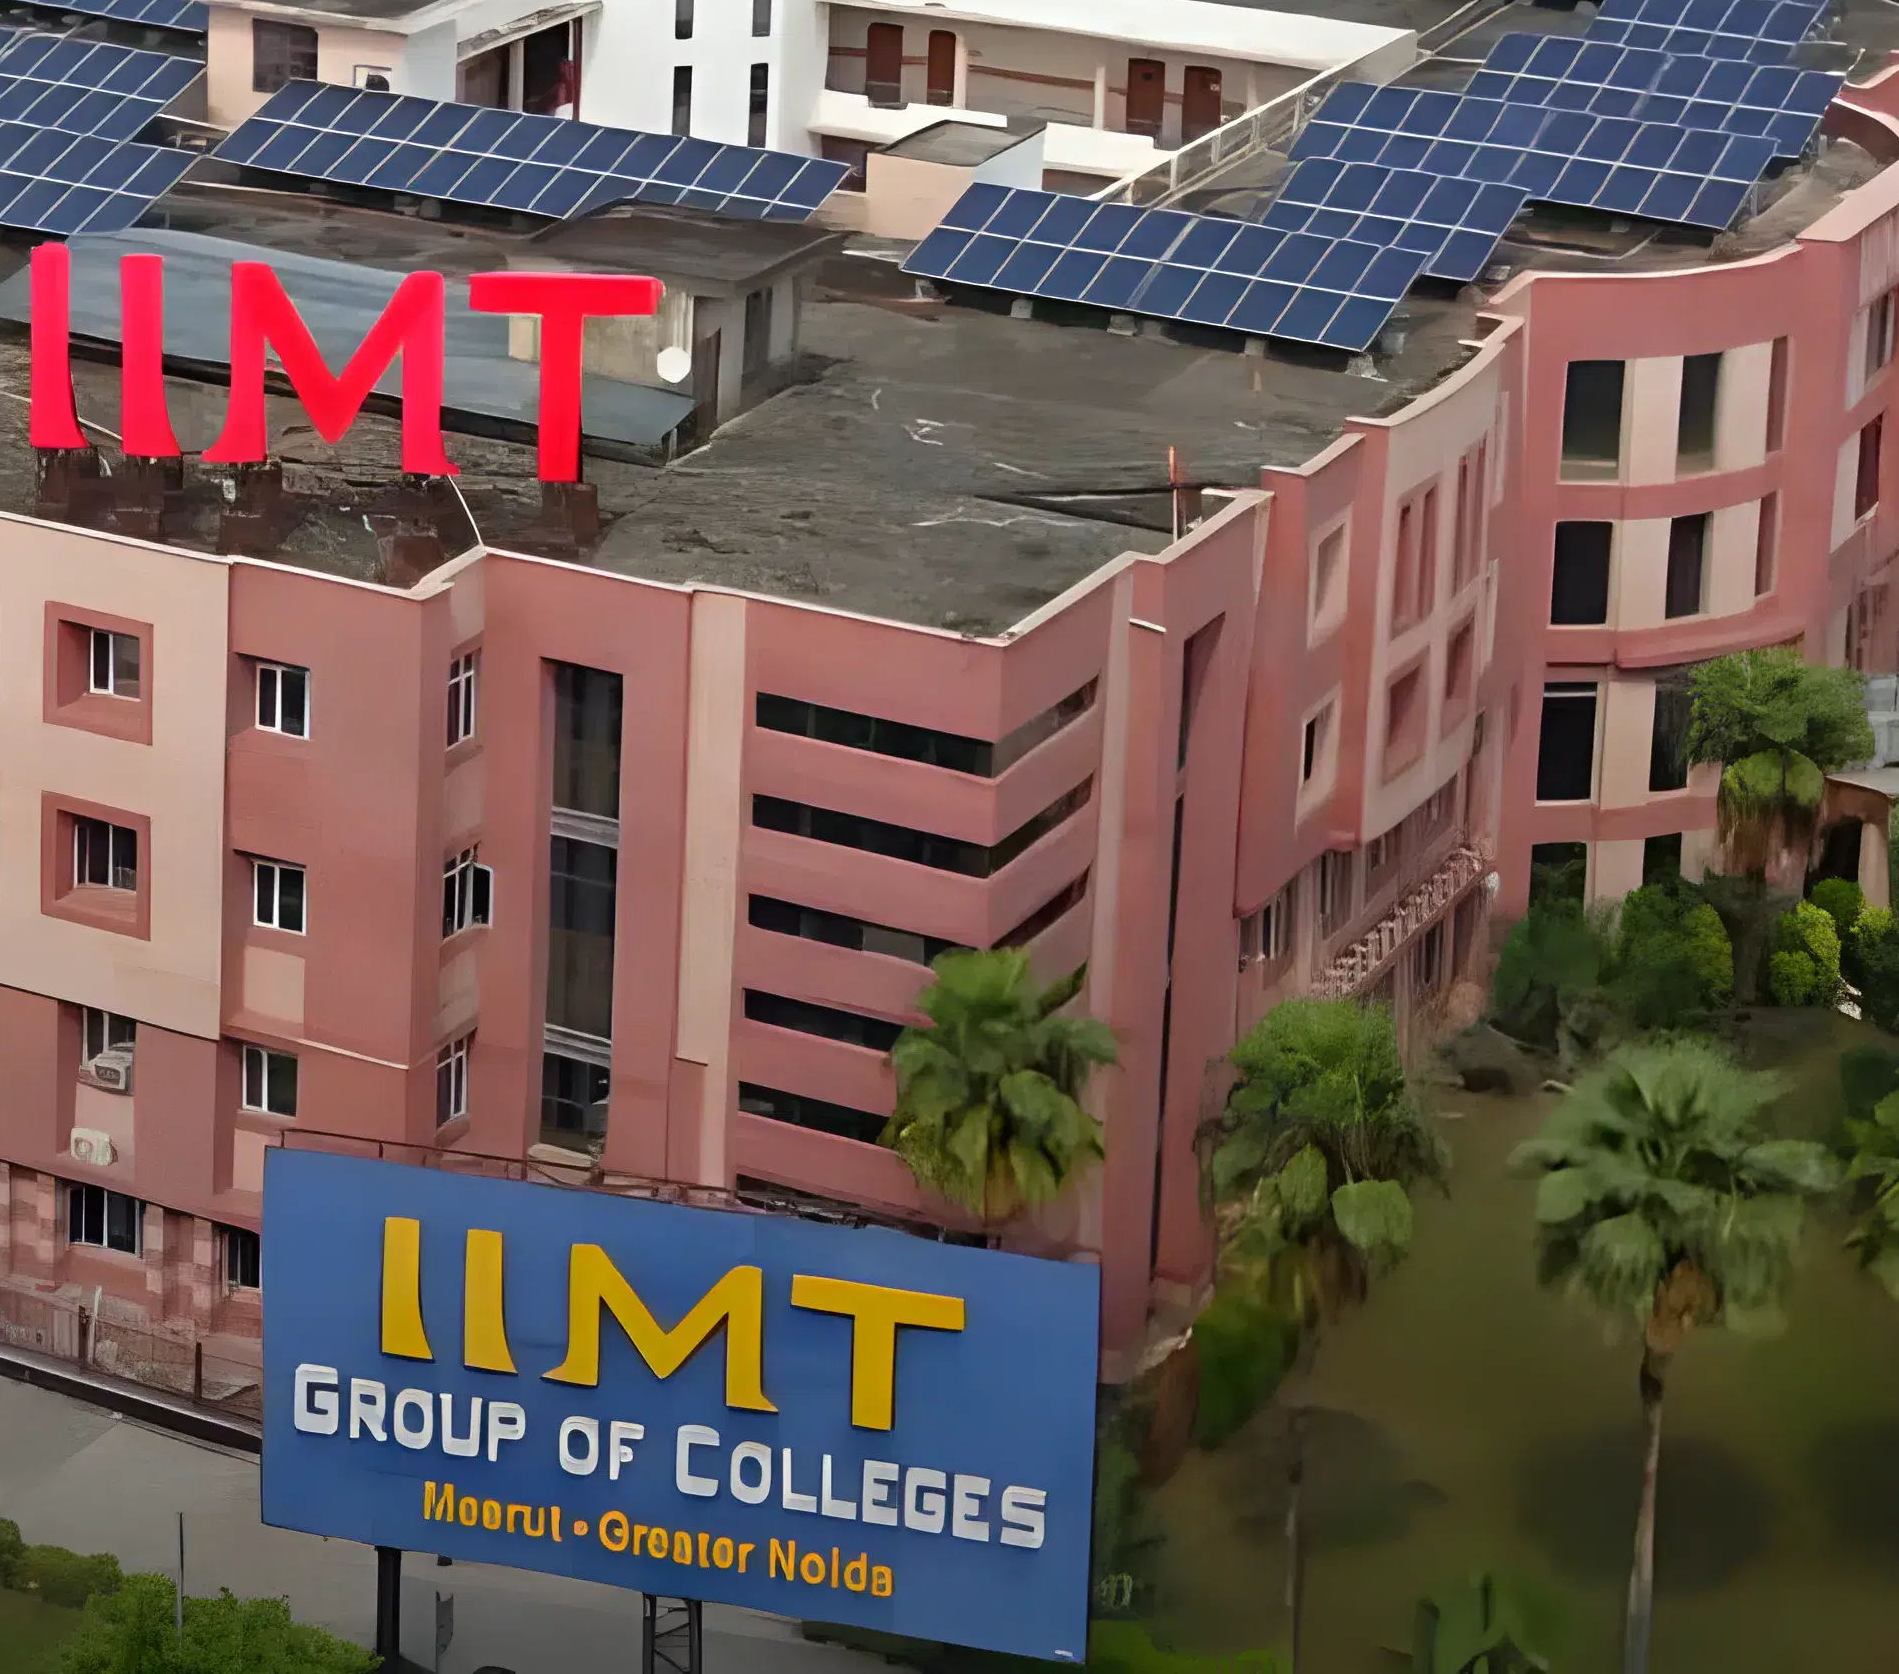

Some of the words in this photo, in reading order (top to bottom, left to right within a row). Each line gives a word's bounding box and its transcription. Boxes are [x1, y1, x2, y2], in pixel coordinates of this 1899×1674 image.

[29, 241, 665, 483] IIMT
[380, 1216, 966, 1431] IIMT
[293, 1363, 526, 1463] GROUP
[558, 1415, 645, 1481] OF
[675, 1424, 1047, 1549] COLLEGES
